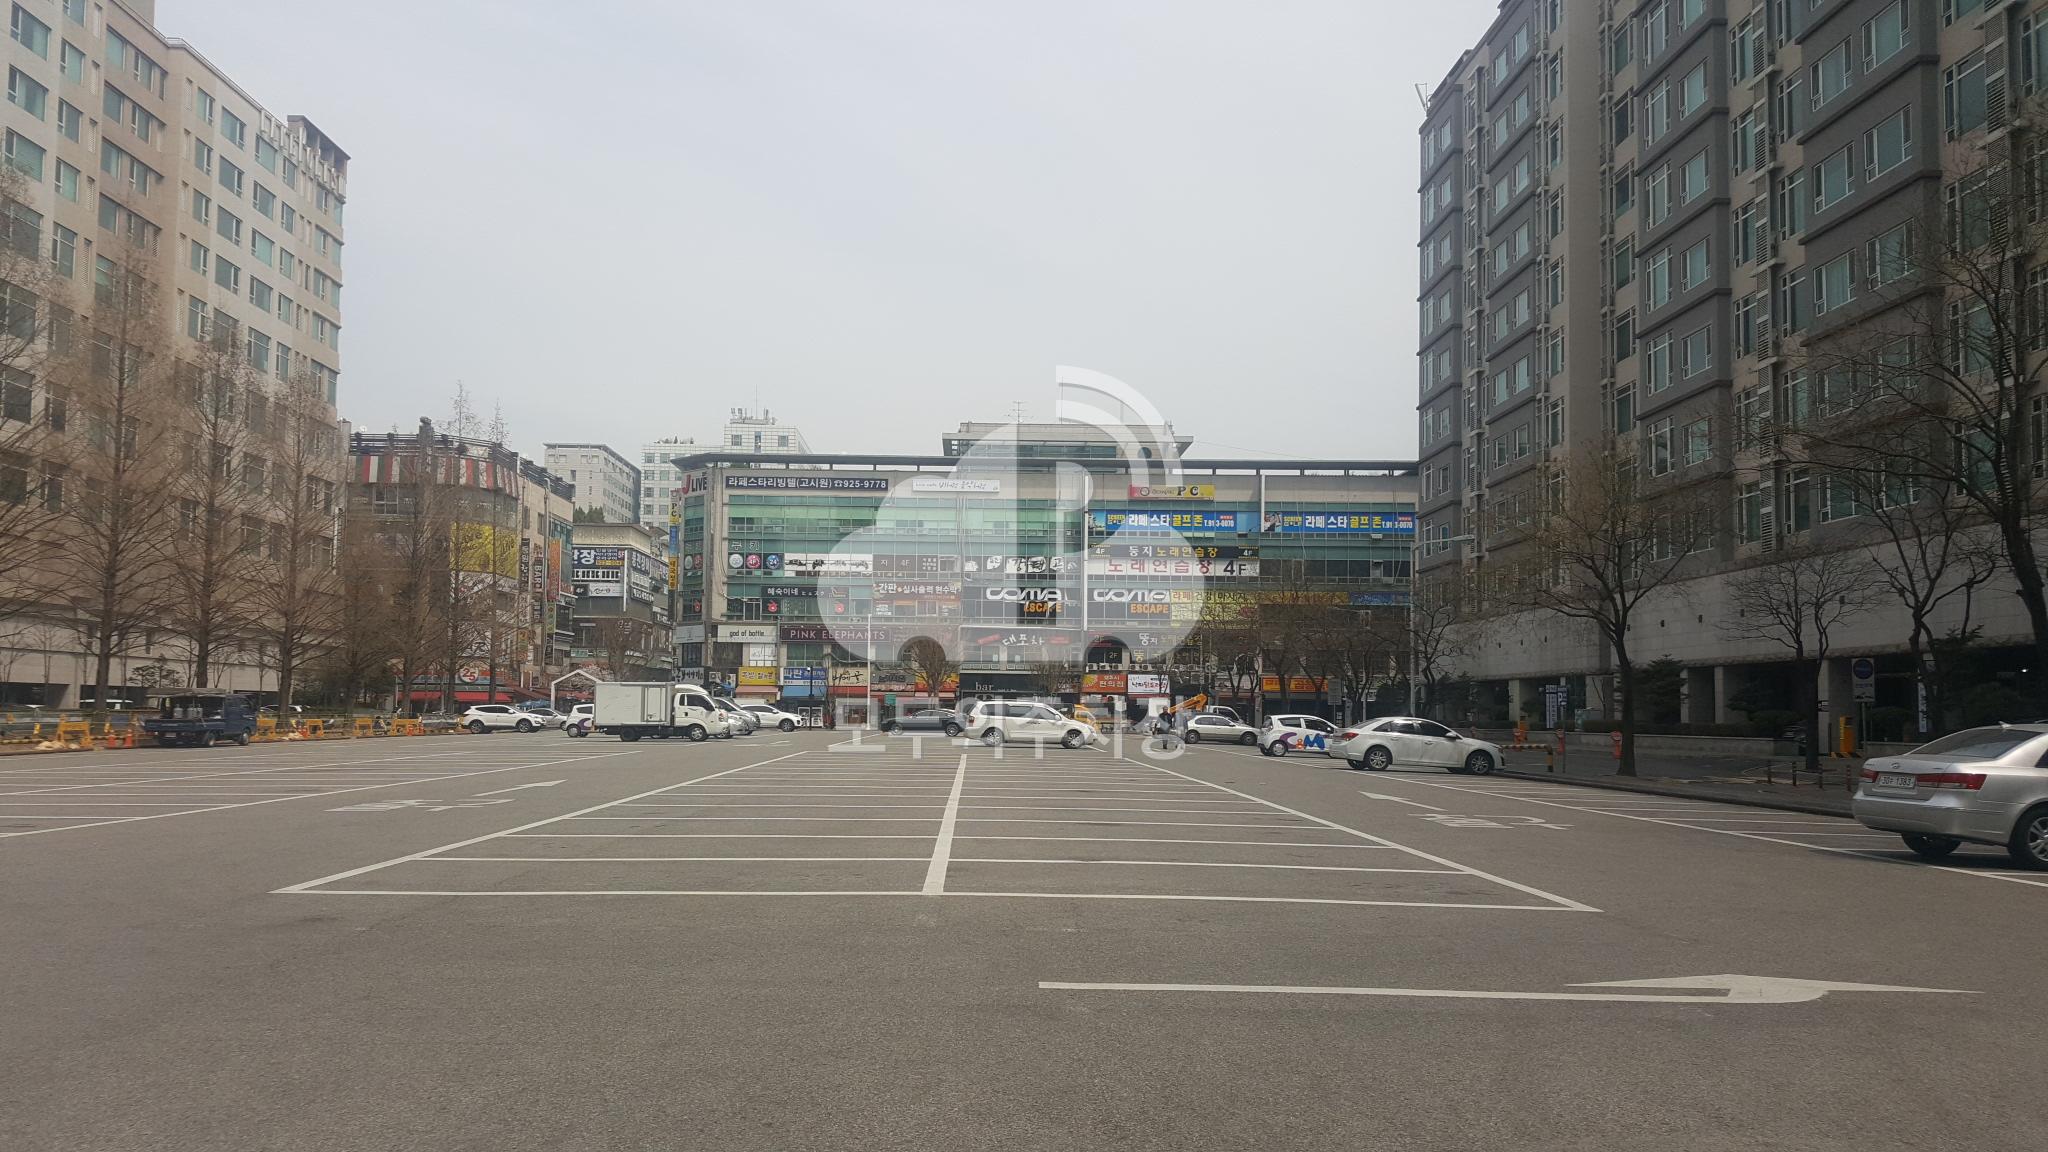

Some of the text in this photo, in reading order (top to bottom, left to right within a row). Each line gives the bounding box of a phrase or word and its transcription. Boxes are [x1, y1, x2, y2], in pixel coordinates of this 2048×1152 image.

[1130, 604, 1169, 614] ESCAPE
[790, 630, 885, 640] PINK ELEPHANTS
[975, 681, 994, 691] bar
